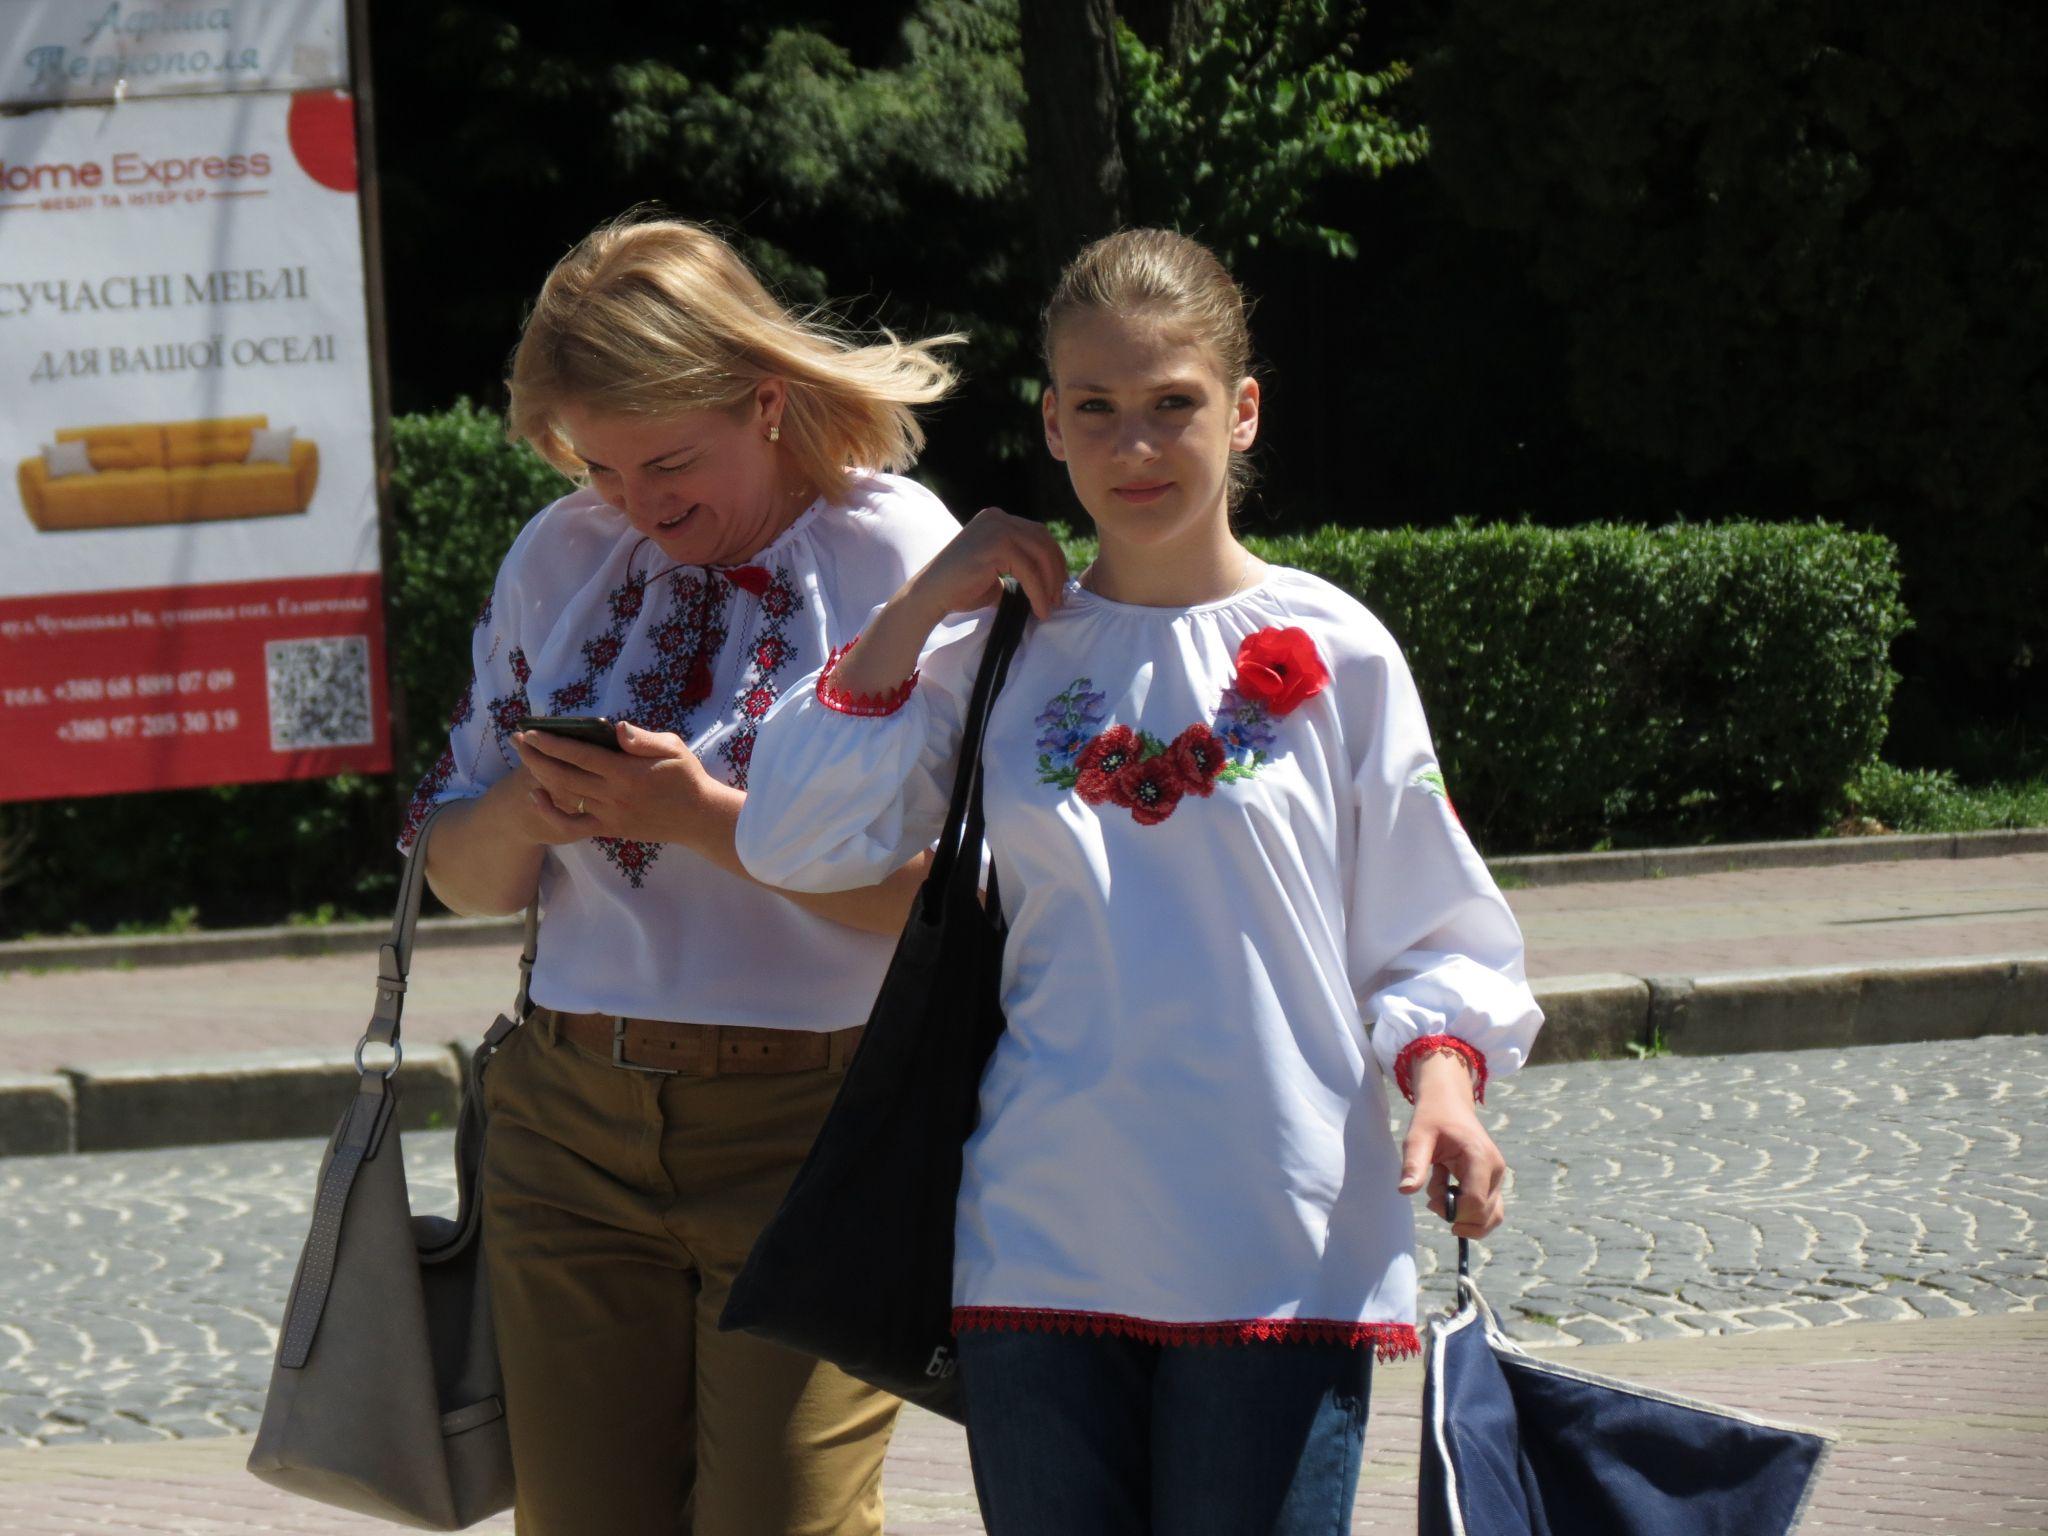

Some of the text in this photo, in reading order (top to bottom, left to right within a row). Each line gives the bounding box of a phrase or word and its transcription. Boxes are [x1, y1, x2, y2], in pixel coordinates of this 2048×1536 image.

[111, 153, 272, 185] Express
[0, 266, 309, 318] СУЧАСНІ МЕБЛІ
[30, 334, 336, 383] ДЛЯ ВАШОЇ ОСЕЛІ
